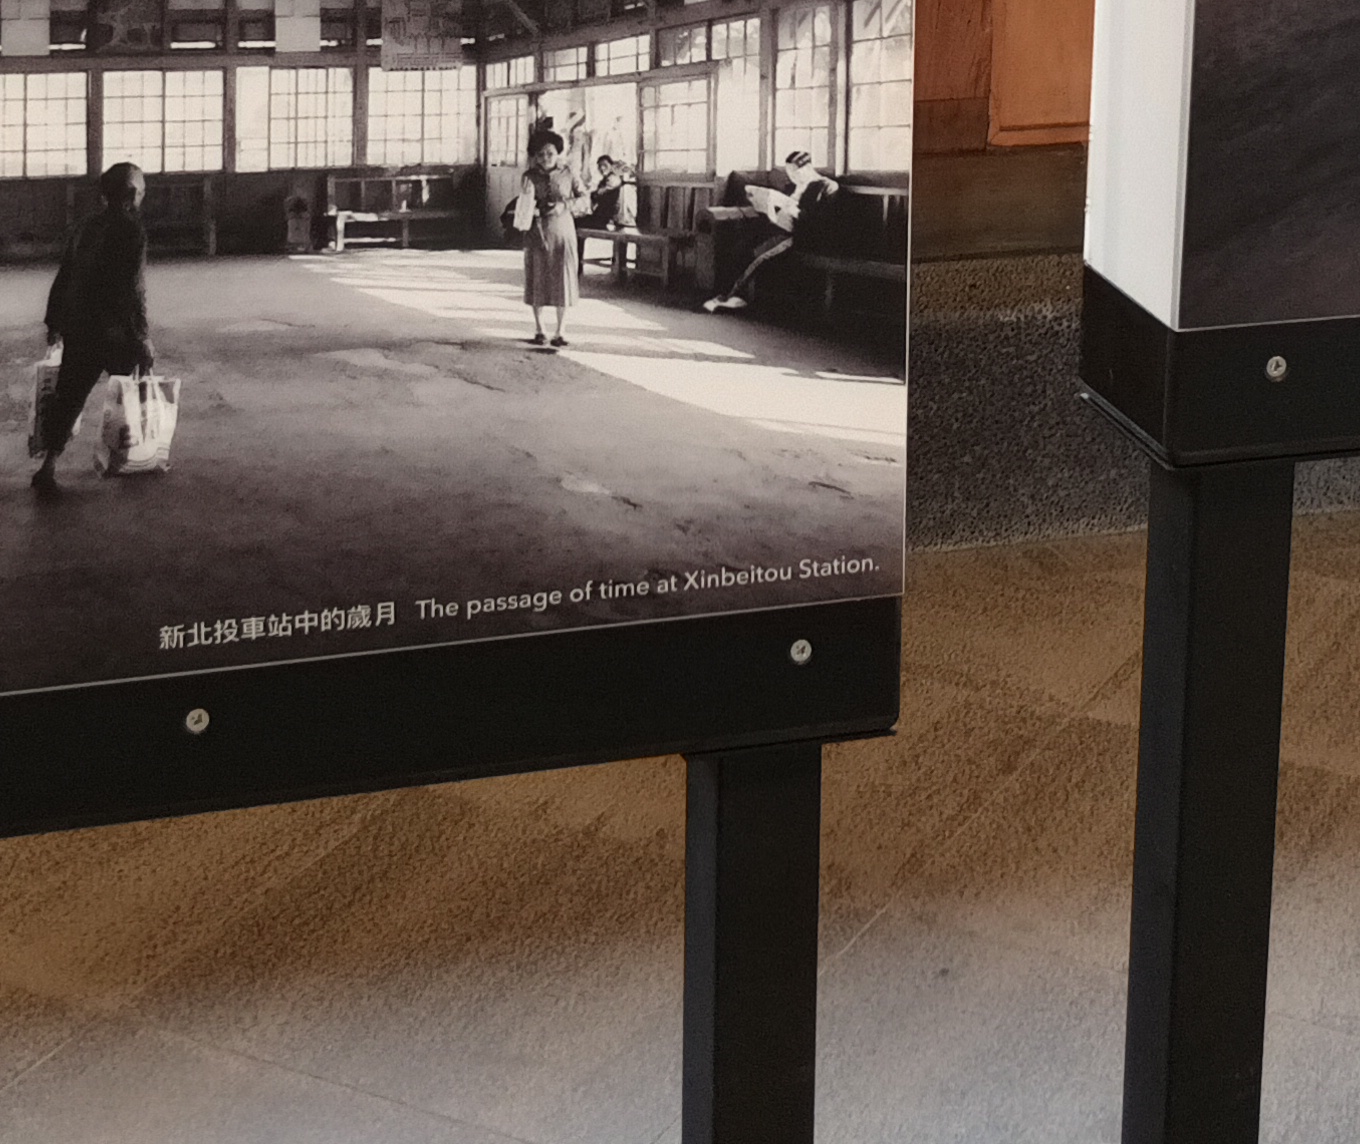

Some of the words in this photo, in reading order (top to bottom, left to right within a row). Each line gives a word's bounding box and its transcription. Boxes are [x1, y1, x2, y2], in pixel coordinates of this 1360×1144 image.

[415, 598, 460, 620] The
[466, 590, 563, 620] passage
[569, 580, 593, 603] of
[599, 579, 650, 600] time
[657, 574, 678, 594] at
[683, 564, 793, 591] Xinbeitou
[798, 555, 881, 580] Station.
[159, 601, 396, 650] 新北投車站中的歲月
